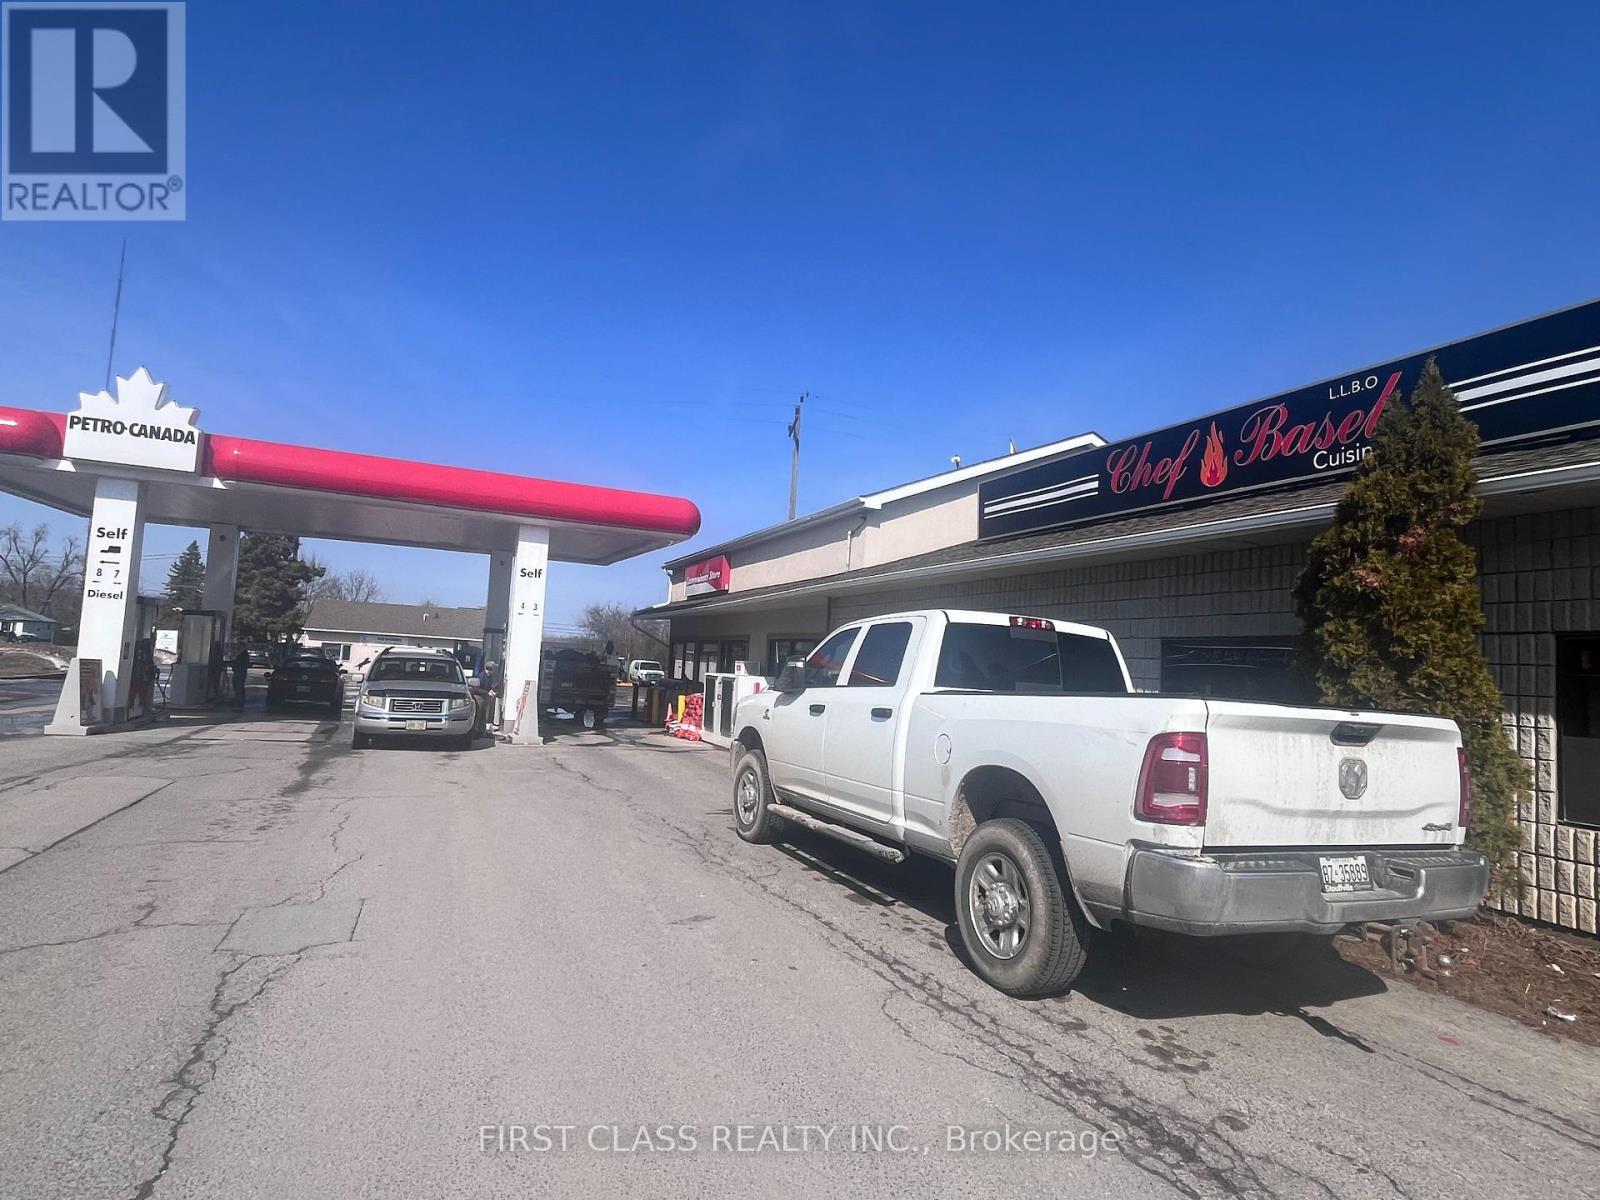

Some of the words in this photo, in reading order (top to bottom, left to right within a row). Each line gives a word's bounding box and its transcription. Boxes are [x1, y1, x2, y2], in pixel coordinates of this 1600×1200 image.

[1329, 375, 1378, 400] L.L.B.O
[1106, 429, 1200, 501] Chef
[1233, 371, 1403, 467] Basel
[96, 527, 128, 540] Self
[96, 568, 103, 577] 8
[114, 569, 121, 579] 7
[520, 567, 543, 579] Self
[87, 589, 124, 600] Diesel
